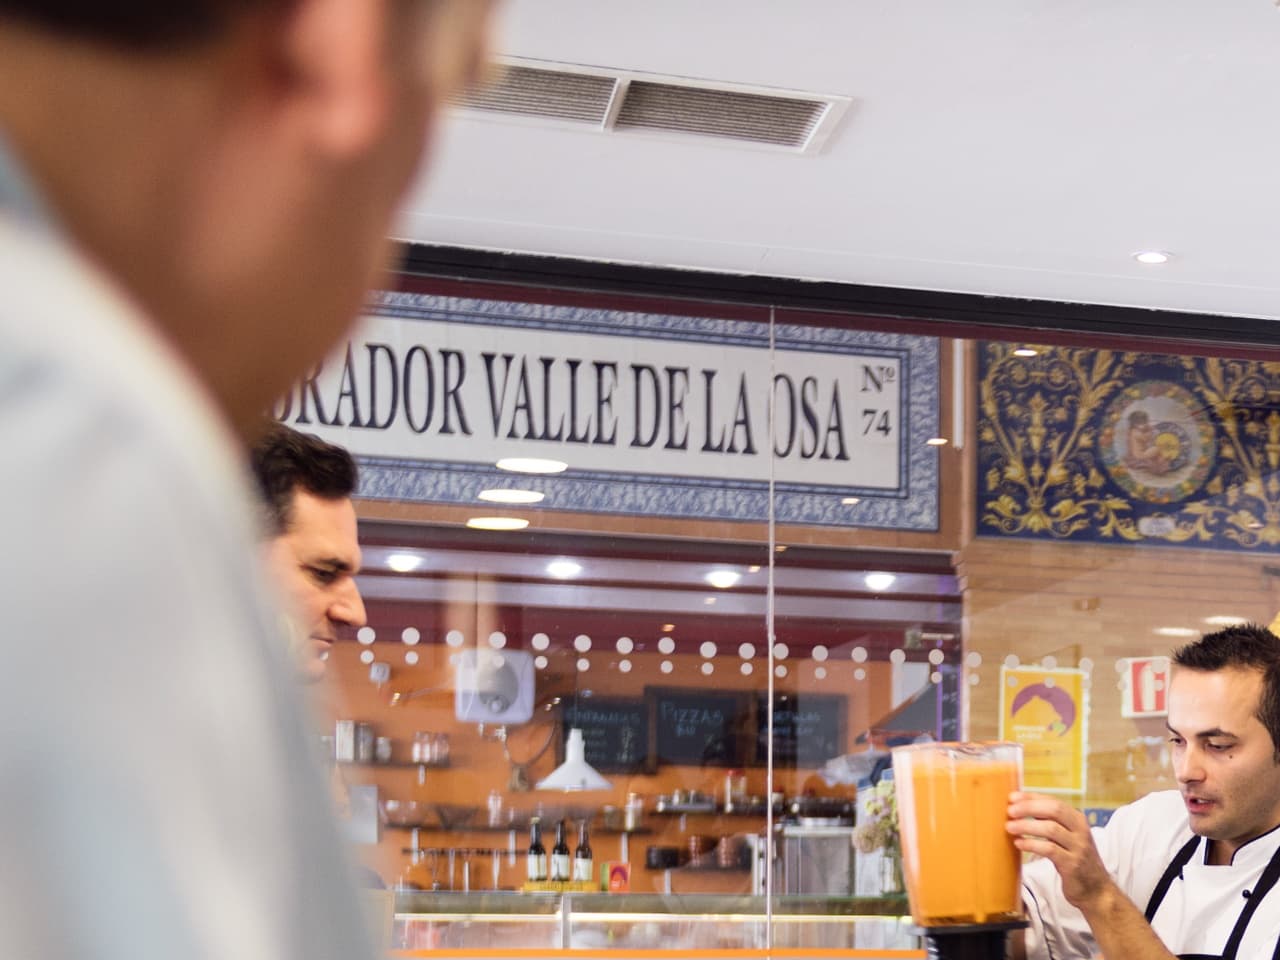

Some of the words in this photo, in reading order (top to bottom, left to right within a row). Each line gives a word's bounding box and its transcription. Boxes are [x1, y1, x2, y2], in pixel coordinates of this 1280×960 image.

[481, 352, 618, 446] VALLE
[630, 363, 690, 451] DE
[701, 370, 758, 455] LA
[767, 373, 850, 461] OSA
[862, 408, 892, 437] 74
[660, 700, 724, 726] PIZZAS
